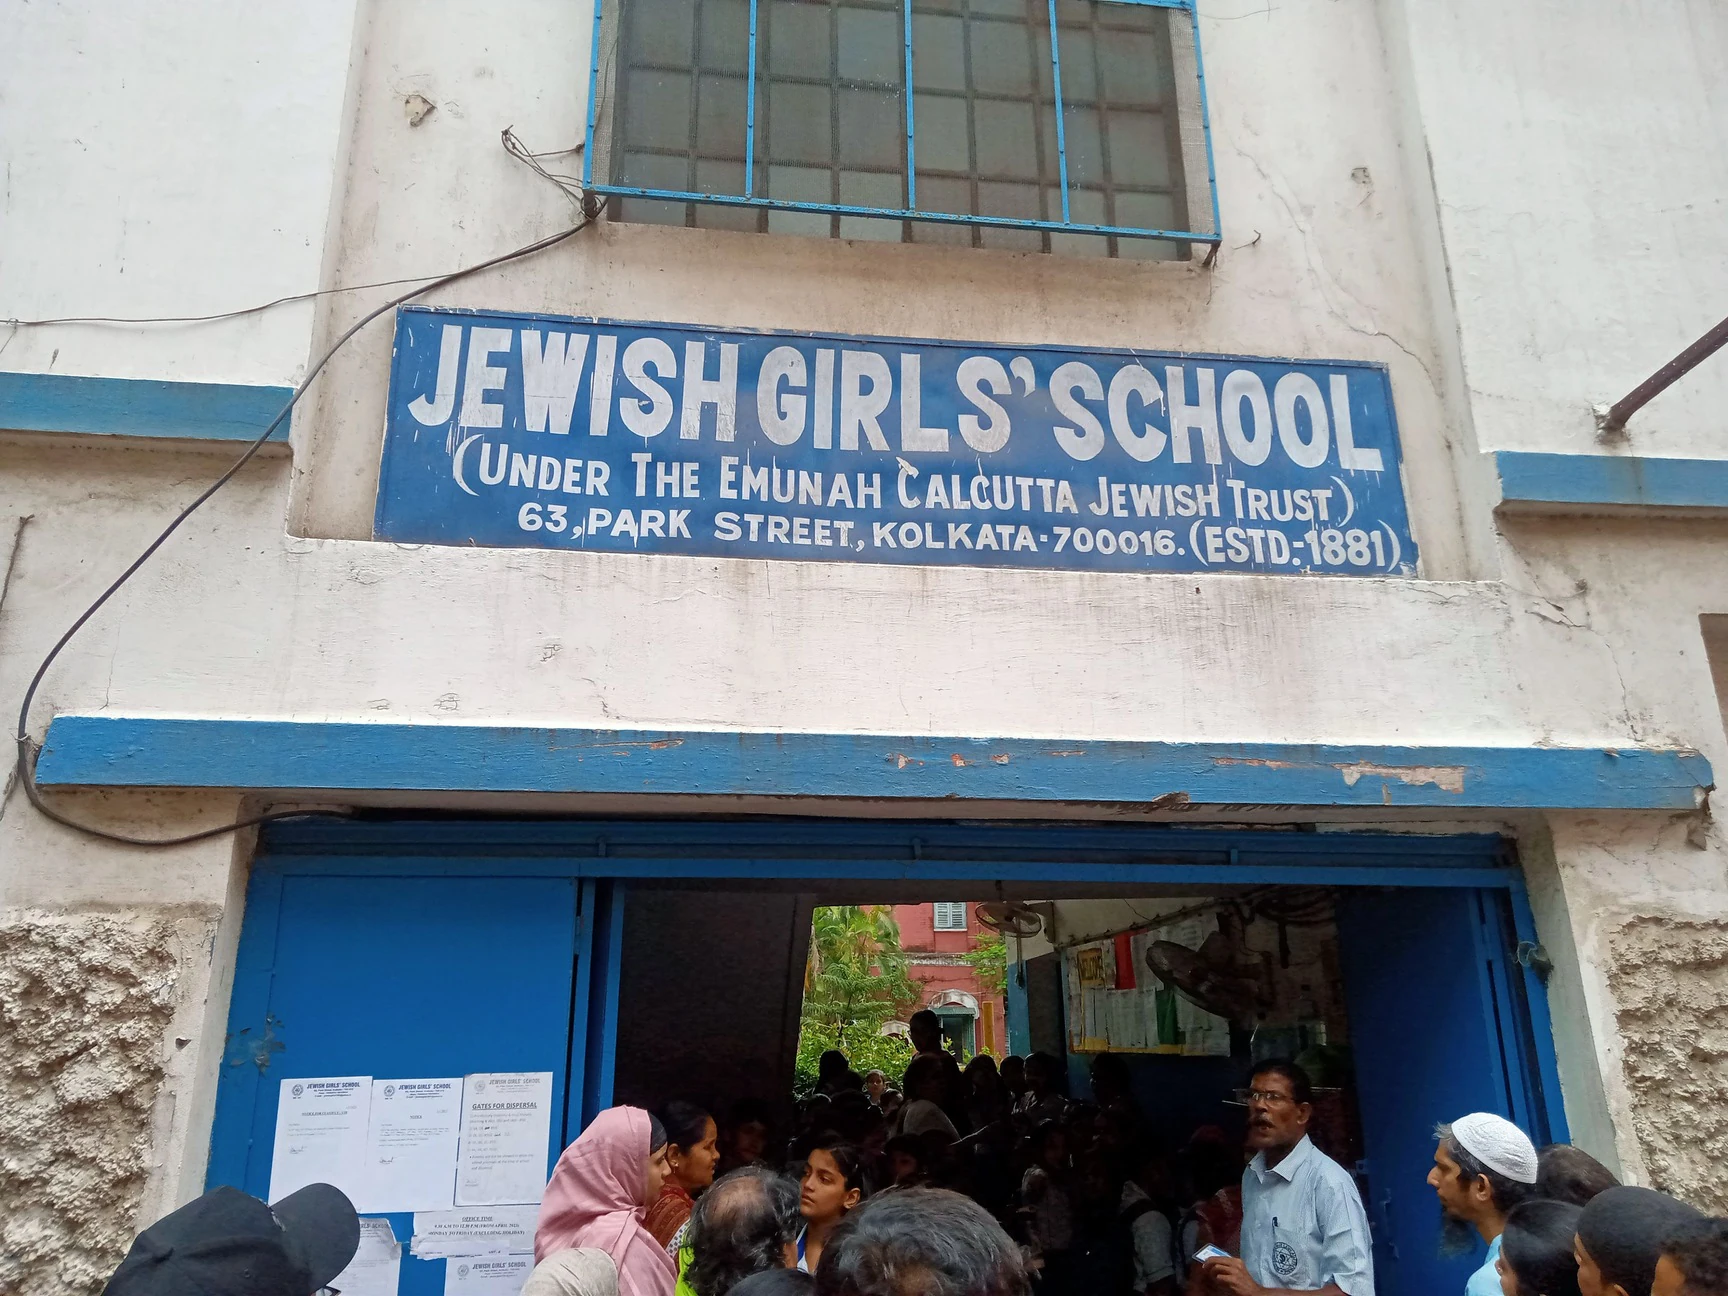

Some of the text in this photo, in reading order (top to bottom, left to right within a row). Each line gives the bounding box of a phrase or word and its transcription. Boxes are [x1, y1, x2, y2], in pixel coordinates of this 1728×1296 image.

[407, 325, 1385, 472] JEWISH GIRLS' SCHOOL
[453, 433, 1355, 528] (UNDER THE EMUNAH CALCUTTA JEWISH TRUST)
[506, 1101, 538, 1109] DISPERSAL
